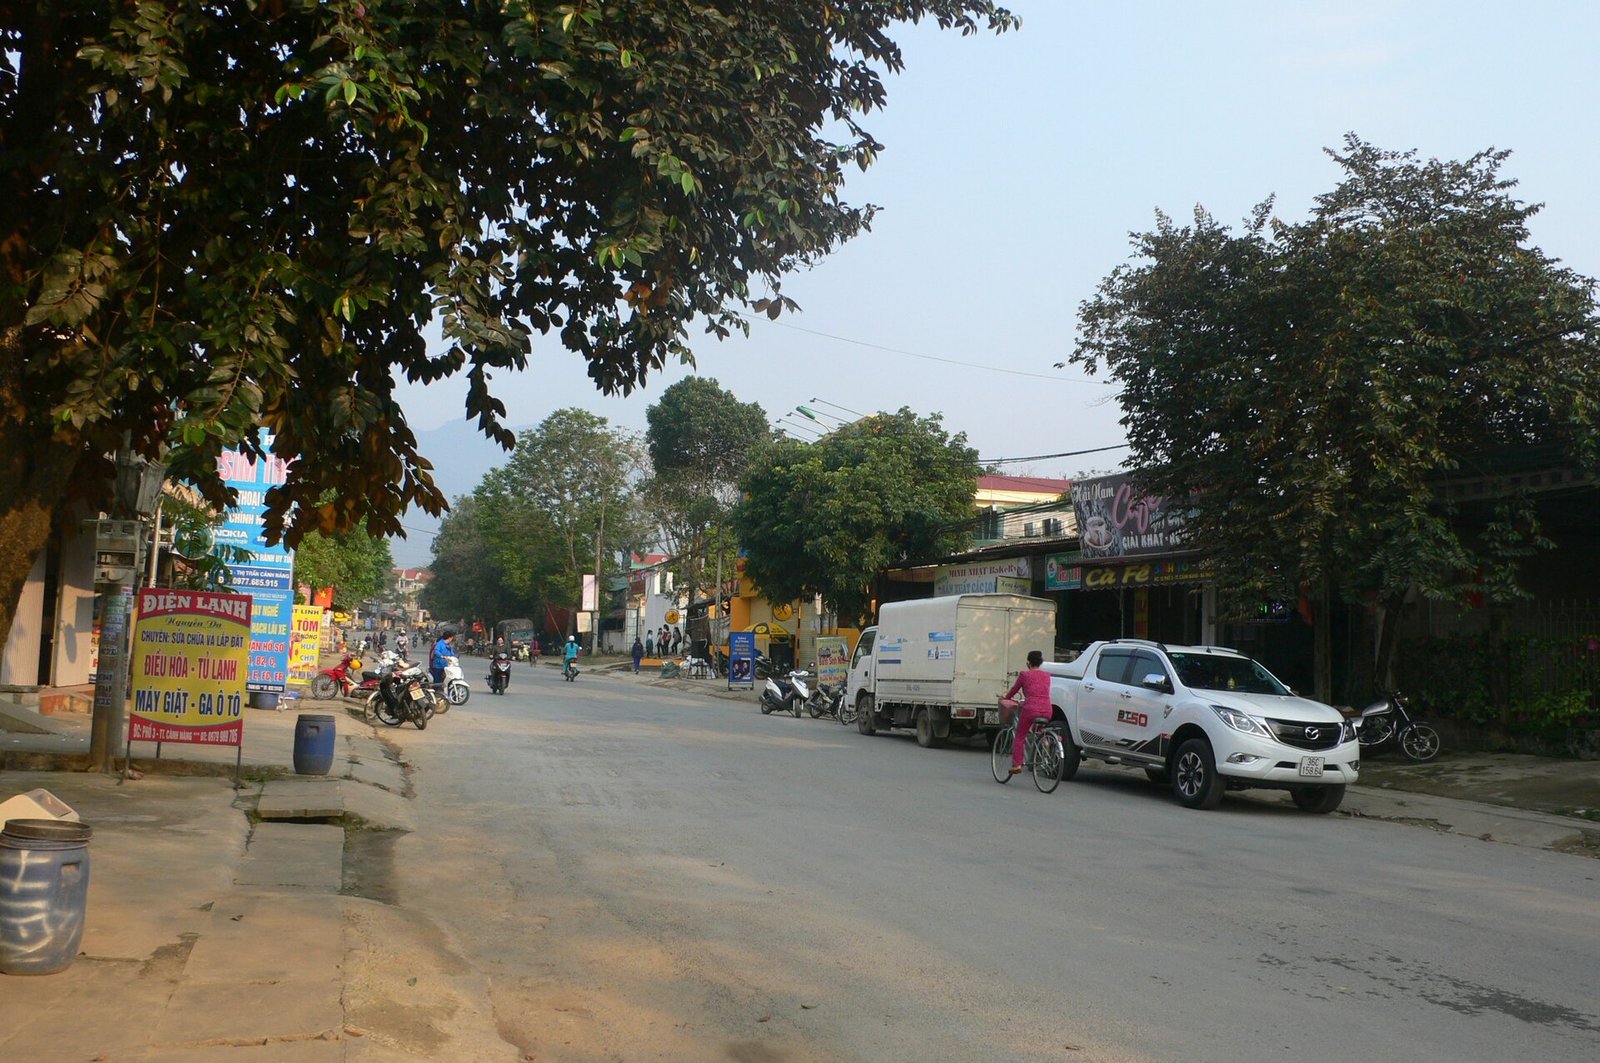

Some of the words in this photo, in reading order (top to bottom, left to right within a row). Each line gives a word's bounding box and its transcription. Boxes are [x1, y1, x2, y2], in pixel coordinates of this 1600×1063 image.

[214, 529, 248, 539] NOKIA
[949, 569, 966, 578] MINH
[232, 577, 279, 588] 0977.685.915
[143, 592, 192, 614] ĐIỆN
[196, 595, 248, 620] LẠNH
[278, 624, 287, 636] XE
[171, 628, 185, 645] SỬA
[187, 631, 205, 646] CHỮA
[198, 651, 210, 679] TỦ
[212, 659, 238, 685] LẠNH
[135, 685, 161, 713] MÁY
[163, 688, 189, 718] GIẶT
[199, 693, 213, 716] GA
[217, 689, 224, 716] Ô
[228, 690, 241, 717] TÔ
[1306, 757, 1319, 767] 36C
